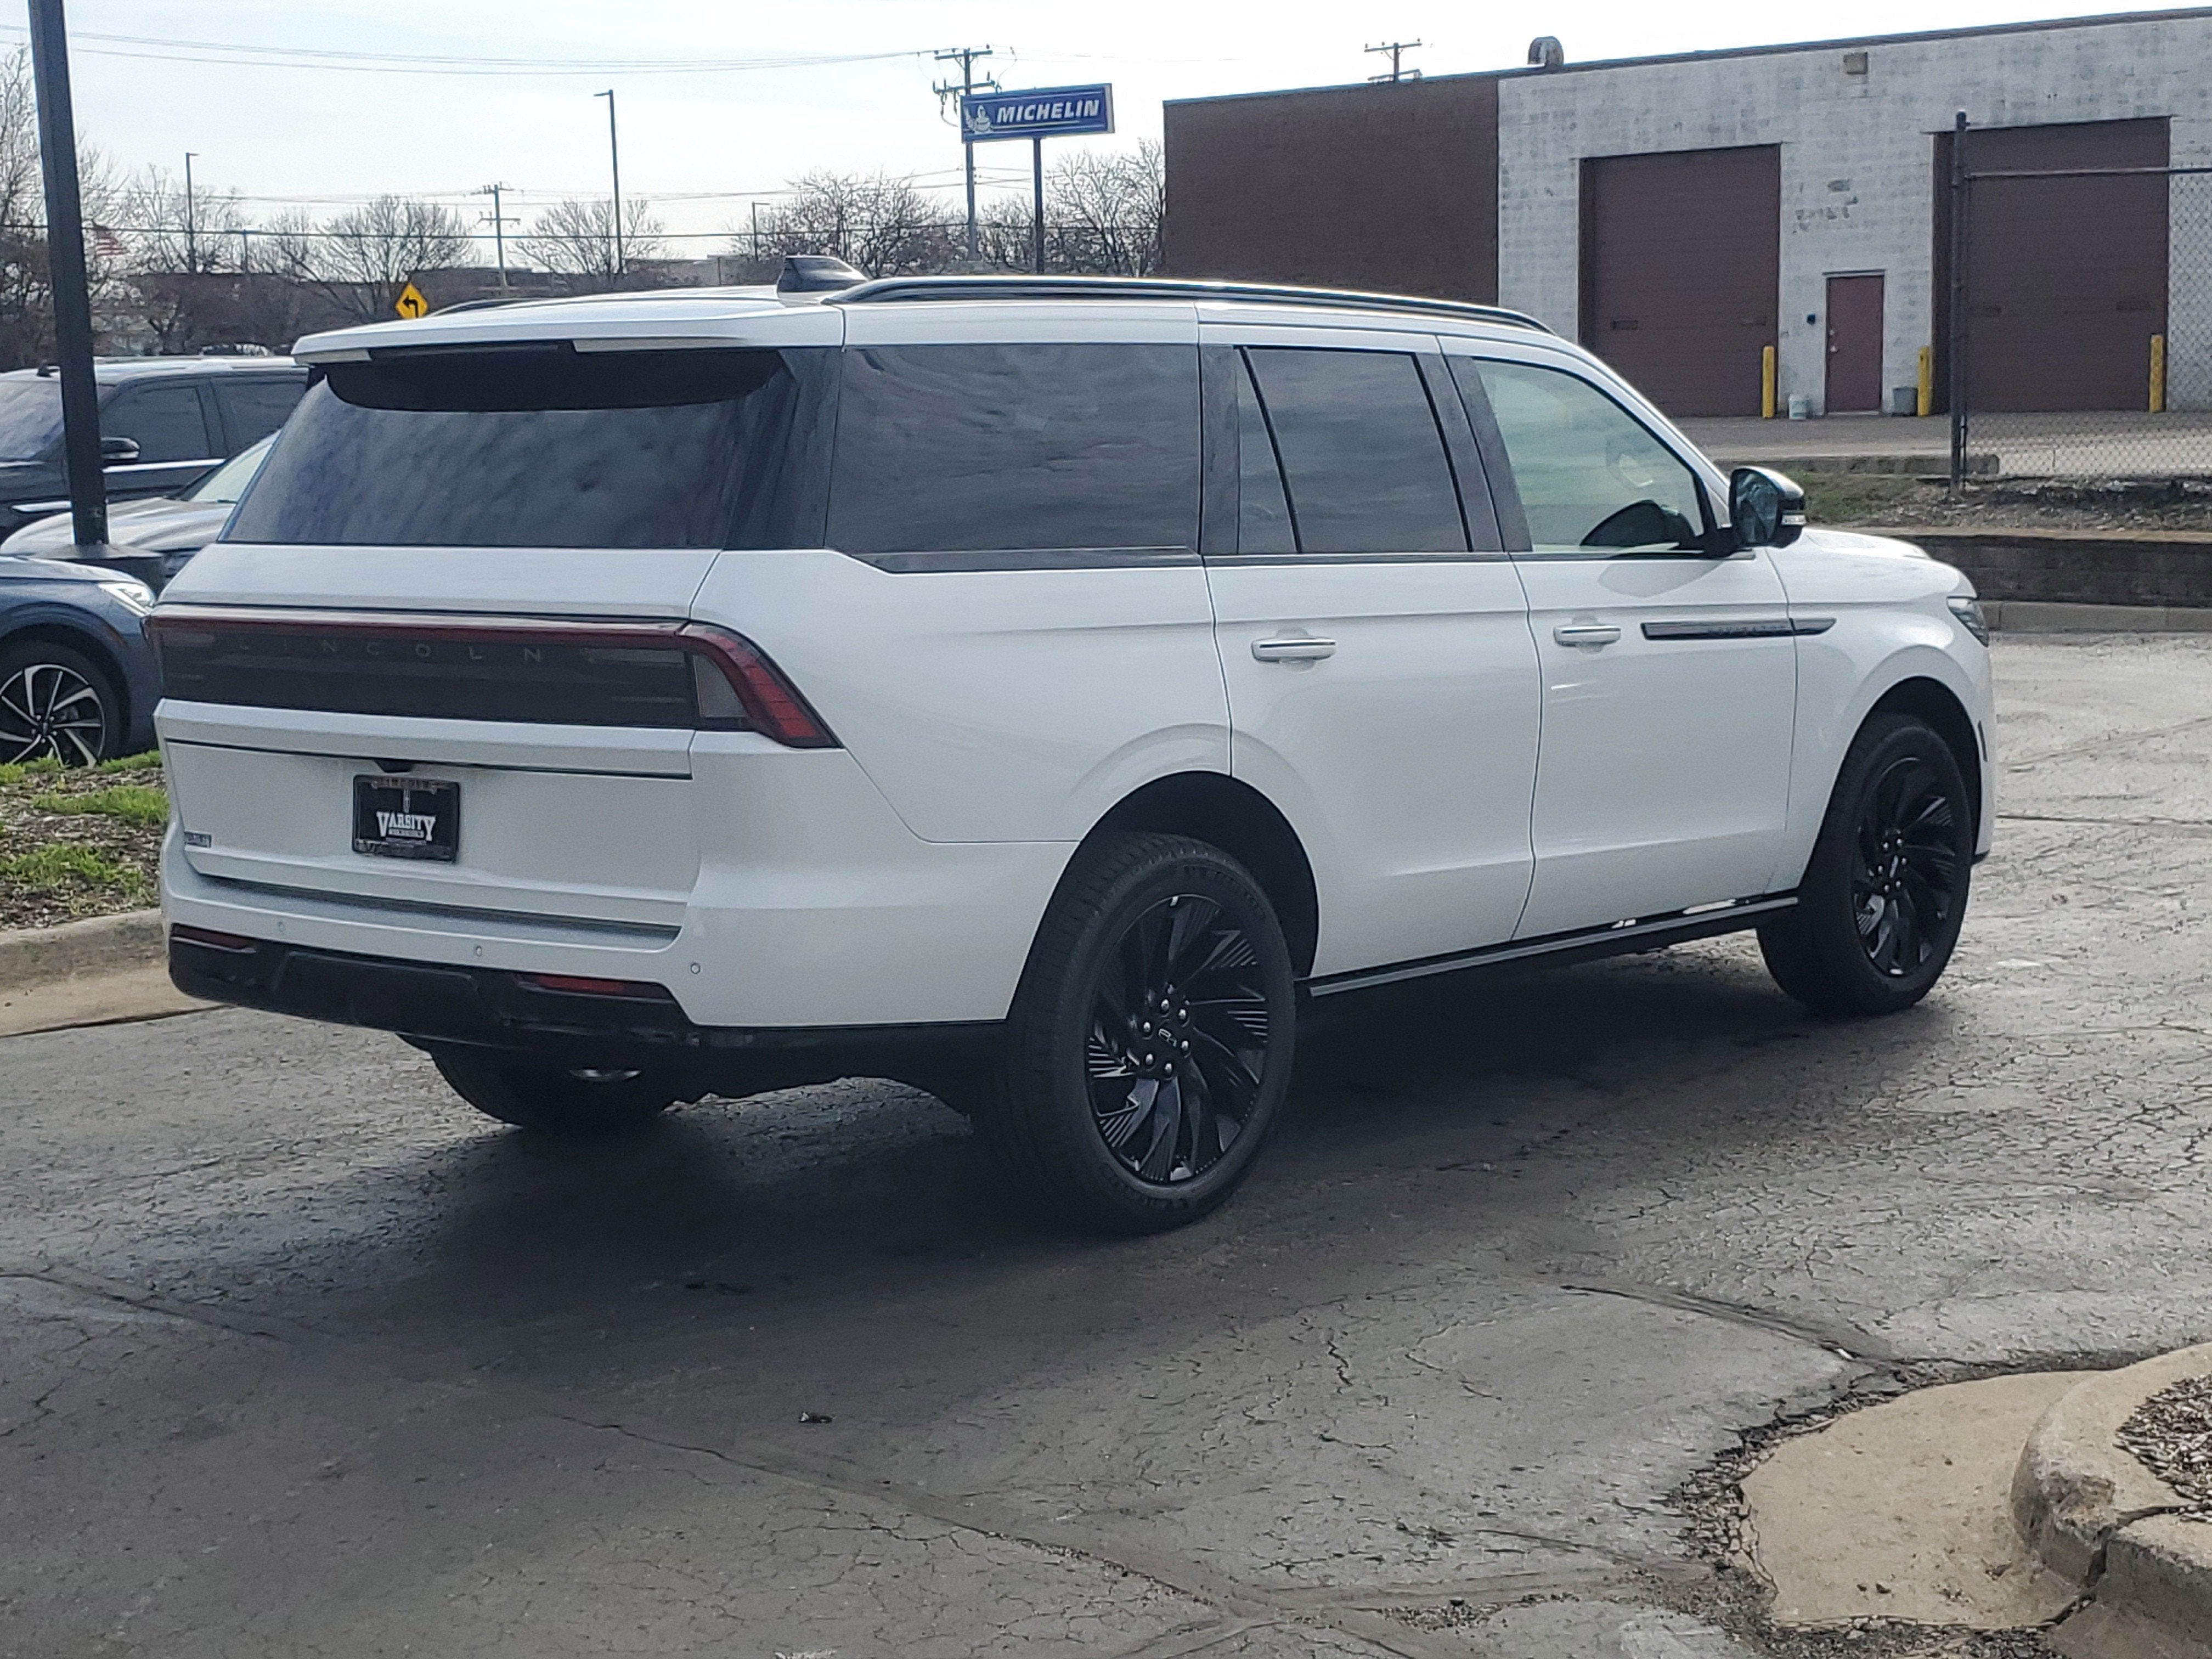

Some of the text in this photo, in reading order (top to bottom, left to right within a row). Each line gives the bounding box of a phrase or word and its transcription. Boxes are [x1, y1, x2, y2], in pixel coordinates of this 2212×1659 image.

[997, 100, 1099, 123] MICHELIN
[238, 636, 541, 662] LINCOLN
[376, 811, 437, 842] VARSITY
